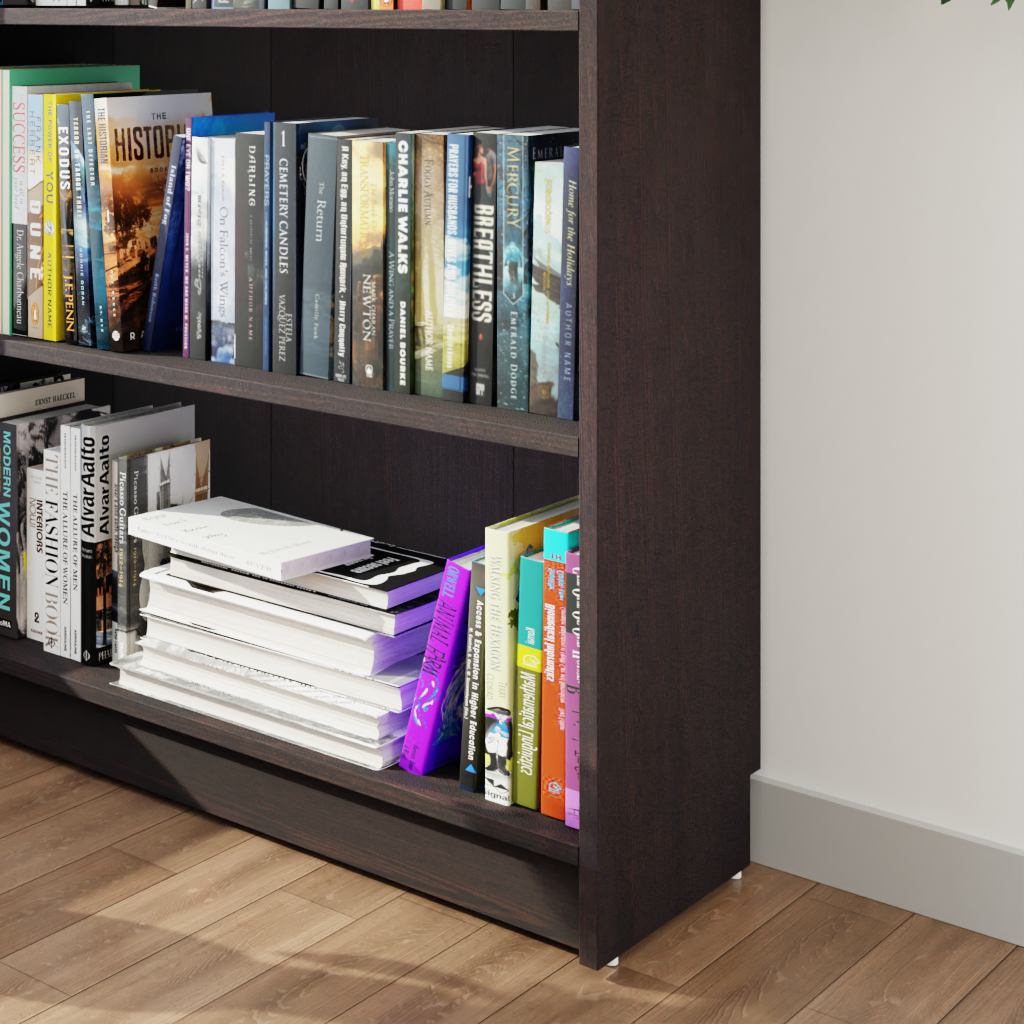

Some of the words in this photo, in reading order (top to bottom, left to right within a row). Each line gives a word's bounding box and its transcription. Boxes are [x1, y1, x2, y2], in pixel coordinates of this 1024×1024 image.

[96, 108, 106, 121] THE
[151, 112, 167, 120] THE
[12, 102, 25, 173] SUCCESS
[98, 123, 109, 164] HISTORIAN
[57, 126, 71, 190] EXODUS
[87, 149, 95, 186] DEFECTOR
[247, 145, 256, 207] DARLING
[398, 140, 409, 213] CHARLIE
[424, 159, 434, 190] FOGGY
[45, 171, 54, 204] YOU
[278, 158, 288, 218] CEMETERY
[506, 146, 521, 229] MERCURY
[567, 179, 578, 206] Home
[219, 207, 227, 225] On
[315, 200, 326, 242] Return
[424, 191, 433, 225] AUTUMN
[566, 208, 577, 223] for
[15, 229, 24, 241] Dr.
[28, 200, 41, 281] DUNE
[278, 221, 288, 274] CANDLES
[339, 214, 348, 261] Unfortunate
[397, 216, 408, 274] WALKS
[566, 225, 576, 242] the
[14, 243, 24, 269] Angele
[471, 204, 495, 323] BREATHLESS
[565, 244, 576, 287] Holidays
[62, 275, 73, 294] J.F.
[339, 262, 347, 293] Remark
[15, 271, 24, 324] Charbonneau
[64, 294, 75, 332] PENN
[217, 281, 228, 317] Wings
[277, 294, 285, 333] VAZQUEZ
[338, 300, 347, 321] Harry
[362, 274, 371, 342] NEWTON
[399, 301, 407, 340] DANIEL
[424, 310, 434, 345] AUTHOR
[510, 311, 518, 359] EMERALD
[564, 303, 573, 346] AUTHOR
[337, 323, 346, 358] Connolly
[424, 346, 434, 371] NAME
[399, 342, 407, 386] BOURKE
[510, 364, 518, 400] DODGE
[563, 352, 572, 382] NAME
[35, 397, 51, 406] ERNST
[53, 392, 76, 404] HAECKEL
[3, 430, 11, 498] MODERN
[45, 454, 59, 496] THE
[45, 501, 59, 587] FASHION
[441, 565, 460, 598] ORWELL
[490, 556, 503, 598] WALKING
[430, 600, 457, 647] ANIMAL
[475, 600, 484, 628] Access
[490, 603, 502, 622] THE
[422, 644, 447, 676] FARM
[471, 639, 482, 680] Expansion
[490, 624, 502, 671] HEXAGON
[472, 681, 479, 690] in
[468, 692, 480, 719] Higher
[467, 720, 477, 760] Education
